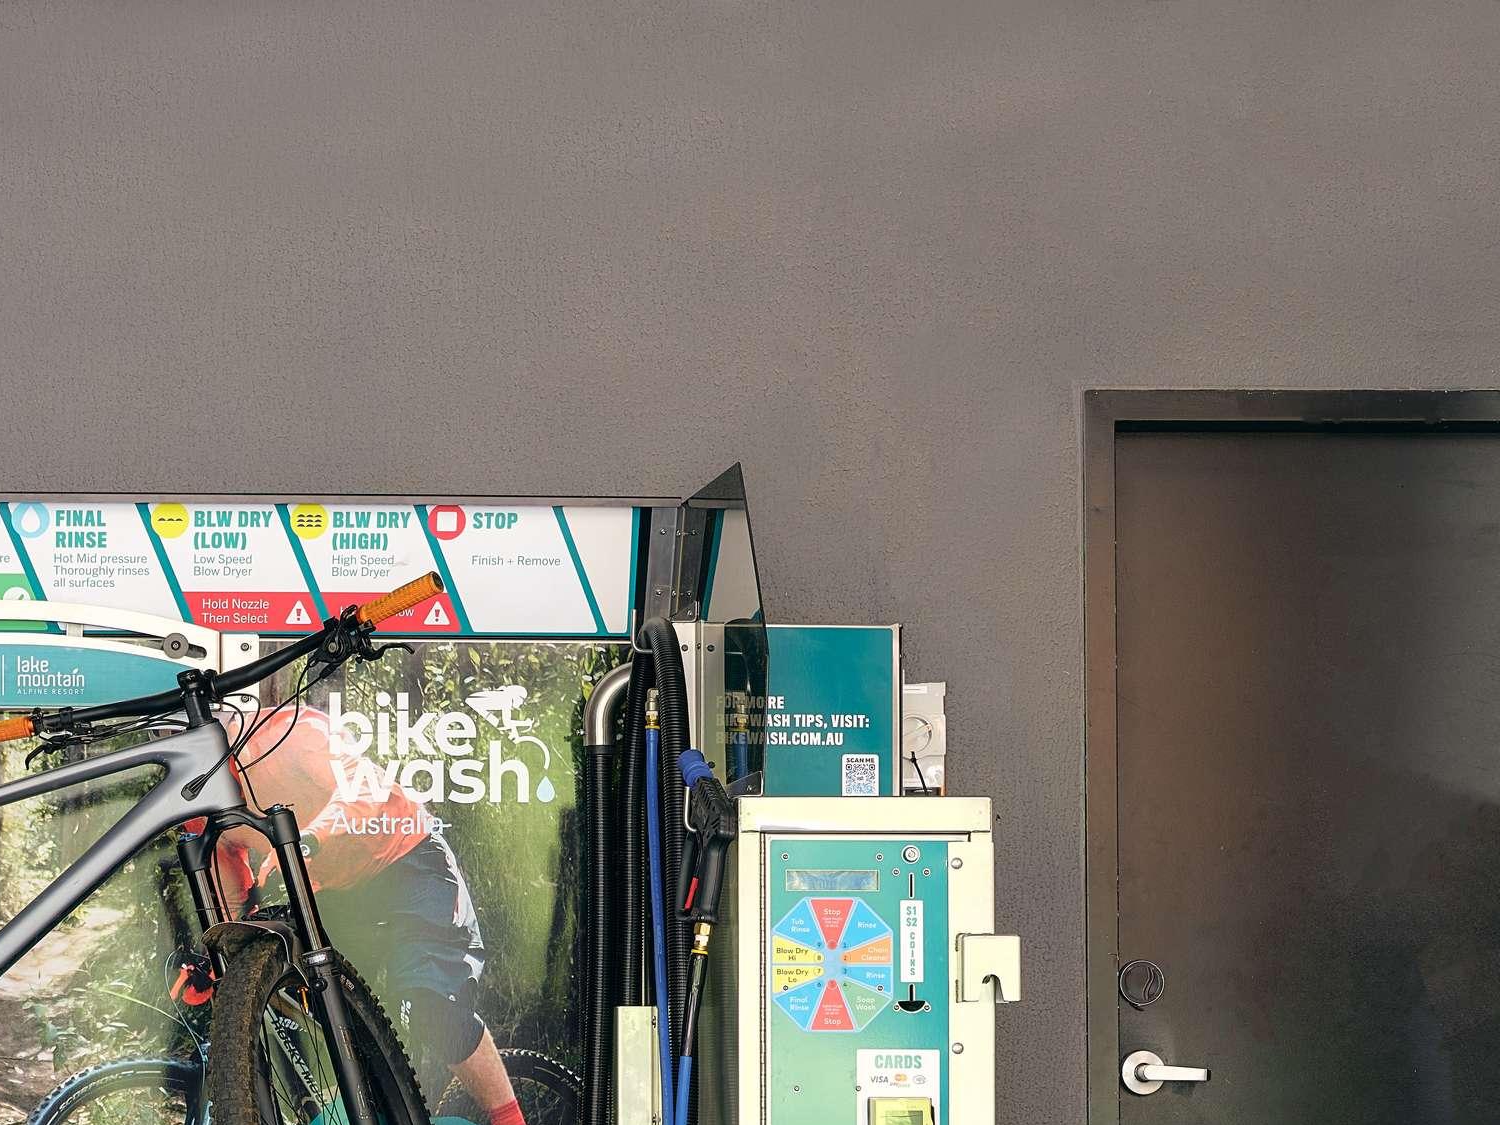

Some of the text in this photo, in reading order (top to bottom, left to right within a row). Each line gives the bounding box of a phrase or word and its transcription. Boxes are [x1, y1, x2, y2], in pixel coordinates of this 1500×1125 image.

[55, 510, 106, 527] FINAL
[194, 511, 273, 528] BLW DRY
[332, 511, 411, 529] BLW DRY
[472, 512, 518, 530] STOP
[55, 531, 107, 548] RINSE
[193, 531, 247, 550] (LOW)
[331, 532, 389, 551] (HIGH)
[53, 554, 148, 566] Hot Mid pressure
[193, 554, 253, 566] Low Speed
[331, 555, 395, 567] High Speed
[471, 555, 504, 566] Finish
[517, 556, 561, 566] Remove
[54, 566, 150, 578] Thoroughly rinses
[193, 566, 253, 578] Blow Dryer
[331, 567, 390, 579] Blow Dryer
[53, 578, 115, 588] all surfaces
[202, 599, 270, 610] Hold Nozzle
[202, 613, 268, 624] Then Select
[17, 656, 49, 673] lake
[17, 669, 85, 687] mountain
[328, 691, 477, 757] bike
[794, 714, 828, 730] TIPS,
[831, 714, 870, 728] VISIT:
[329, 740, 530, 804] wash
[329, 810, 445, 835] Australia
[823, 908, 841, 917] Stop
[857, 921, 877, 929] Rinse
[795, 947, 809, 955] Dry
[795, 968, 809, 976] Dry
[823, 1017, 842, 1026] Stop
[874, 1054, 922, 1069] CARDS
[870, 1075, 889, 1083] VISA
